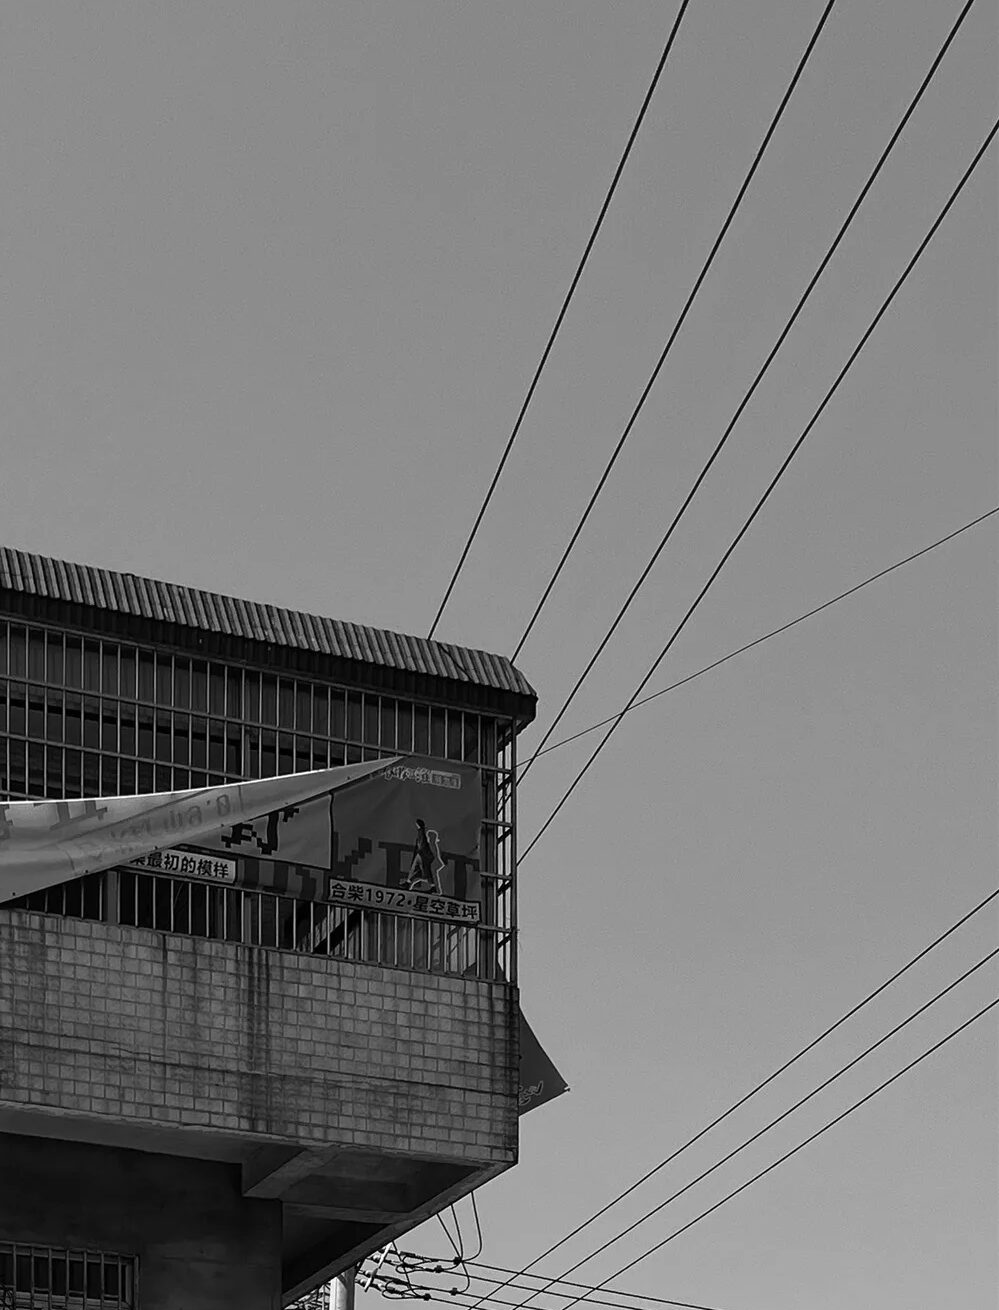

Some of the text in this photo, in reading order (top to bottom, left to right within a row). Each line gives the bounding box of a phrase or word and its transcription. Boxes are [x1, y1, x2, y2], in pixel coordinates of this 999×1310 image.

[331, 882, 479, 920] 合柴1972·星空草坪
